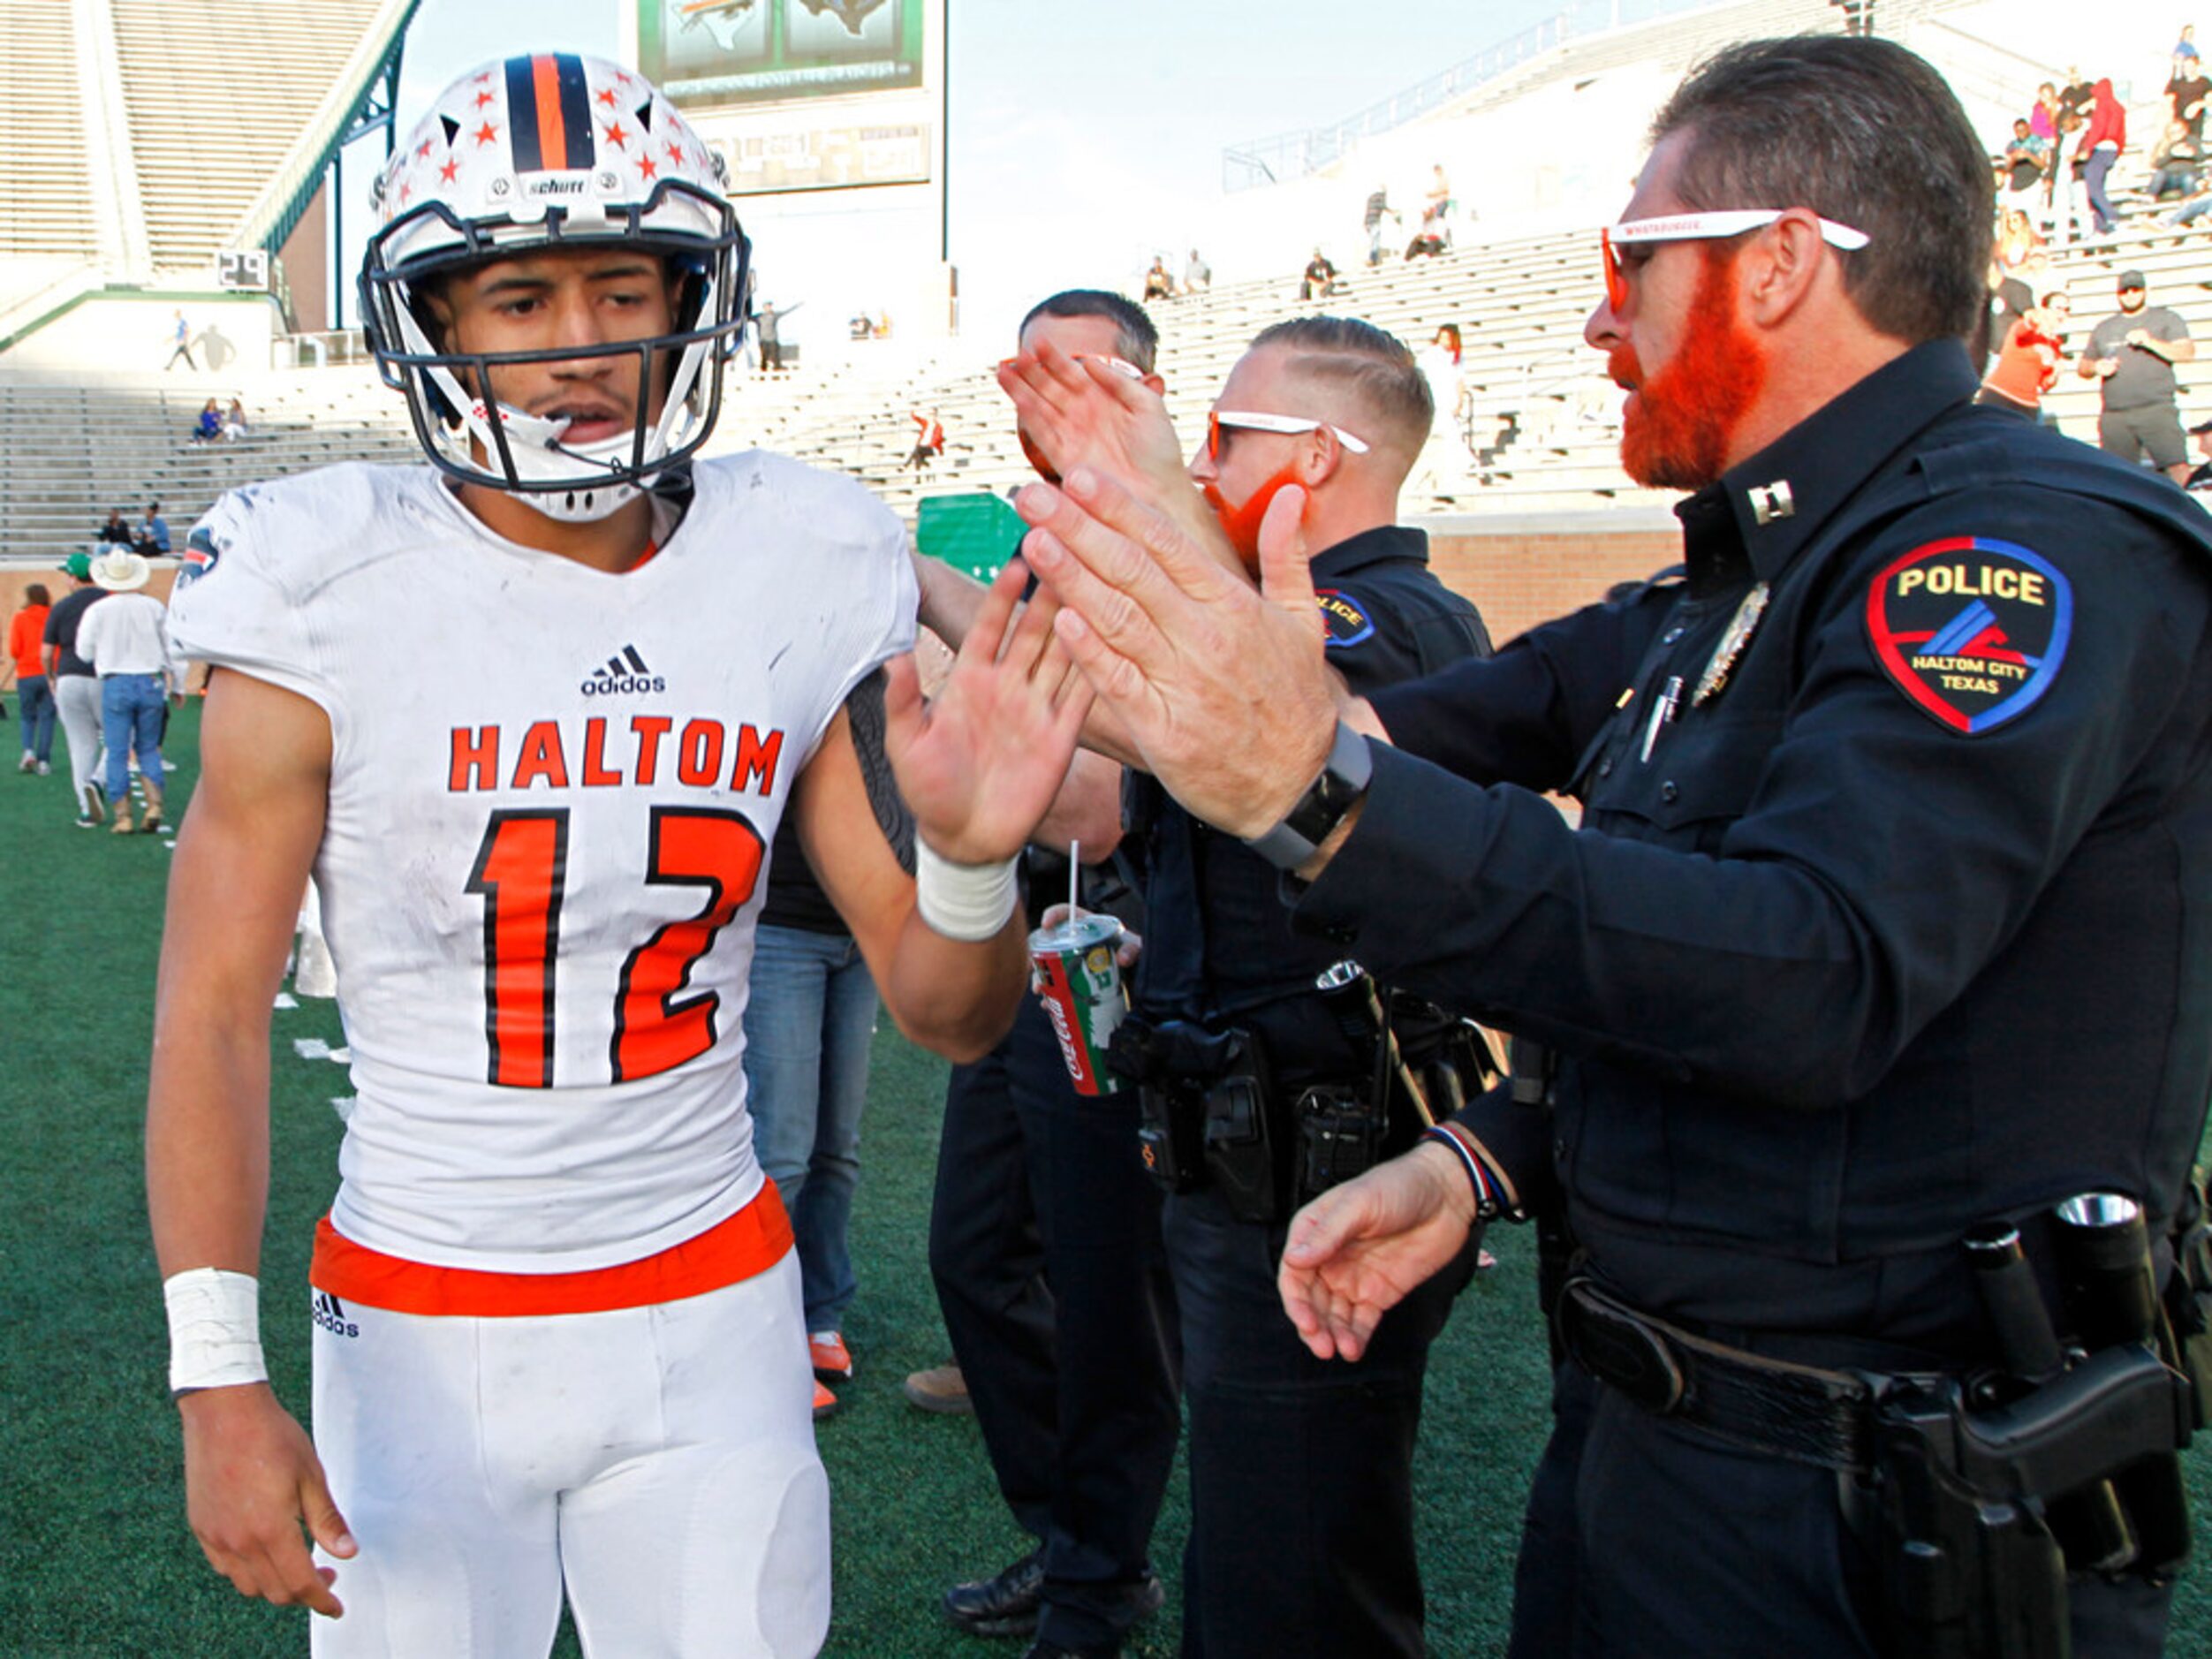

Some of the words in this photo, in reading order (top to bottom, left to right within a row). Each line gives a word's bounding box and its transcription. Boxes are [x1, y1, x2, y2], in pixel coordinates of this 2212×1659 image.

[531, 178, 584, 193] schutt
[220, 253, 267, 286] 29
[1898, 564, 2045, 606] POLICE
[1315, 596, 1363, 626] LICE
[1912, 655, 1984, 673] HALTOM
[1989, 661, 2026, 680] CITY
[580, 675, 666, 696] adidas
[1941, 674, 1999, 694] TEXAS
[448, 714, 785, 797] HALTOM
[464, 806, 767, 1088] 12
